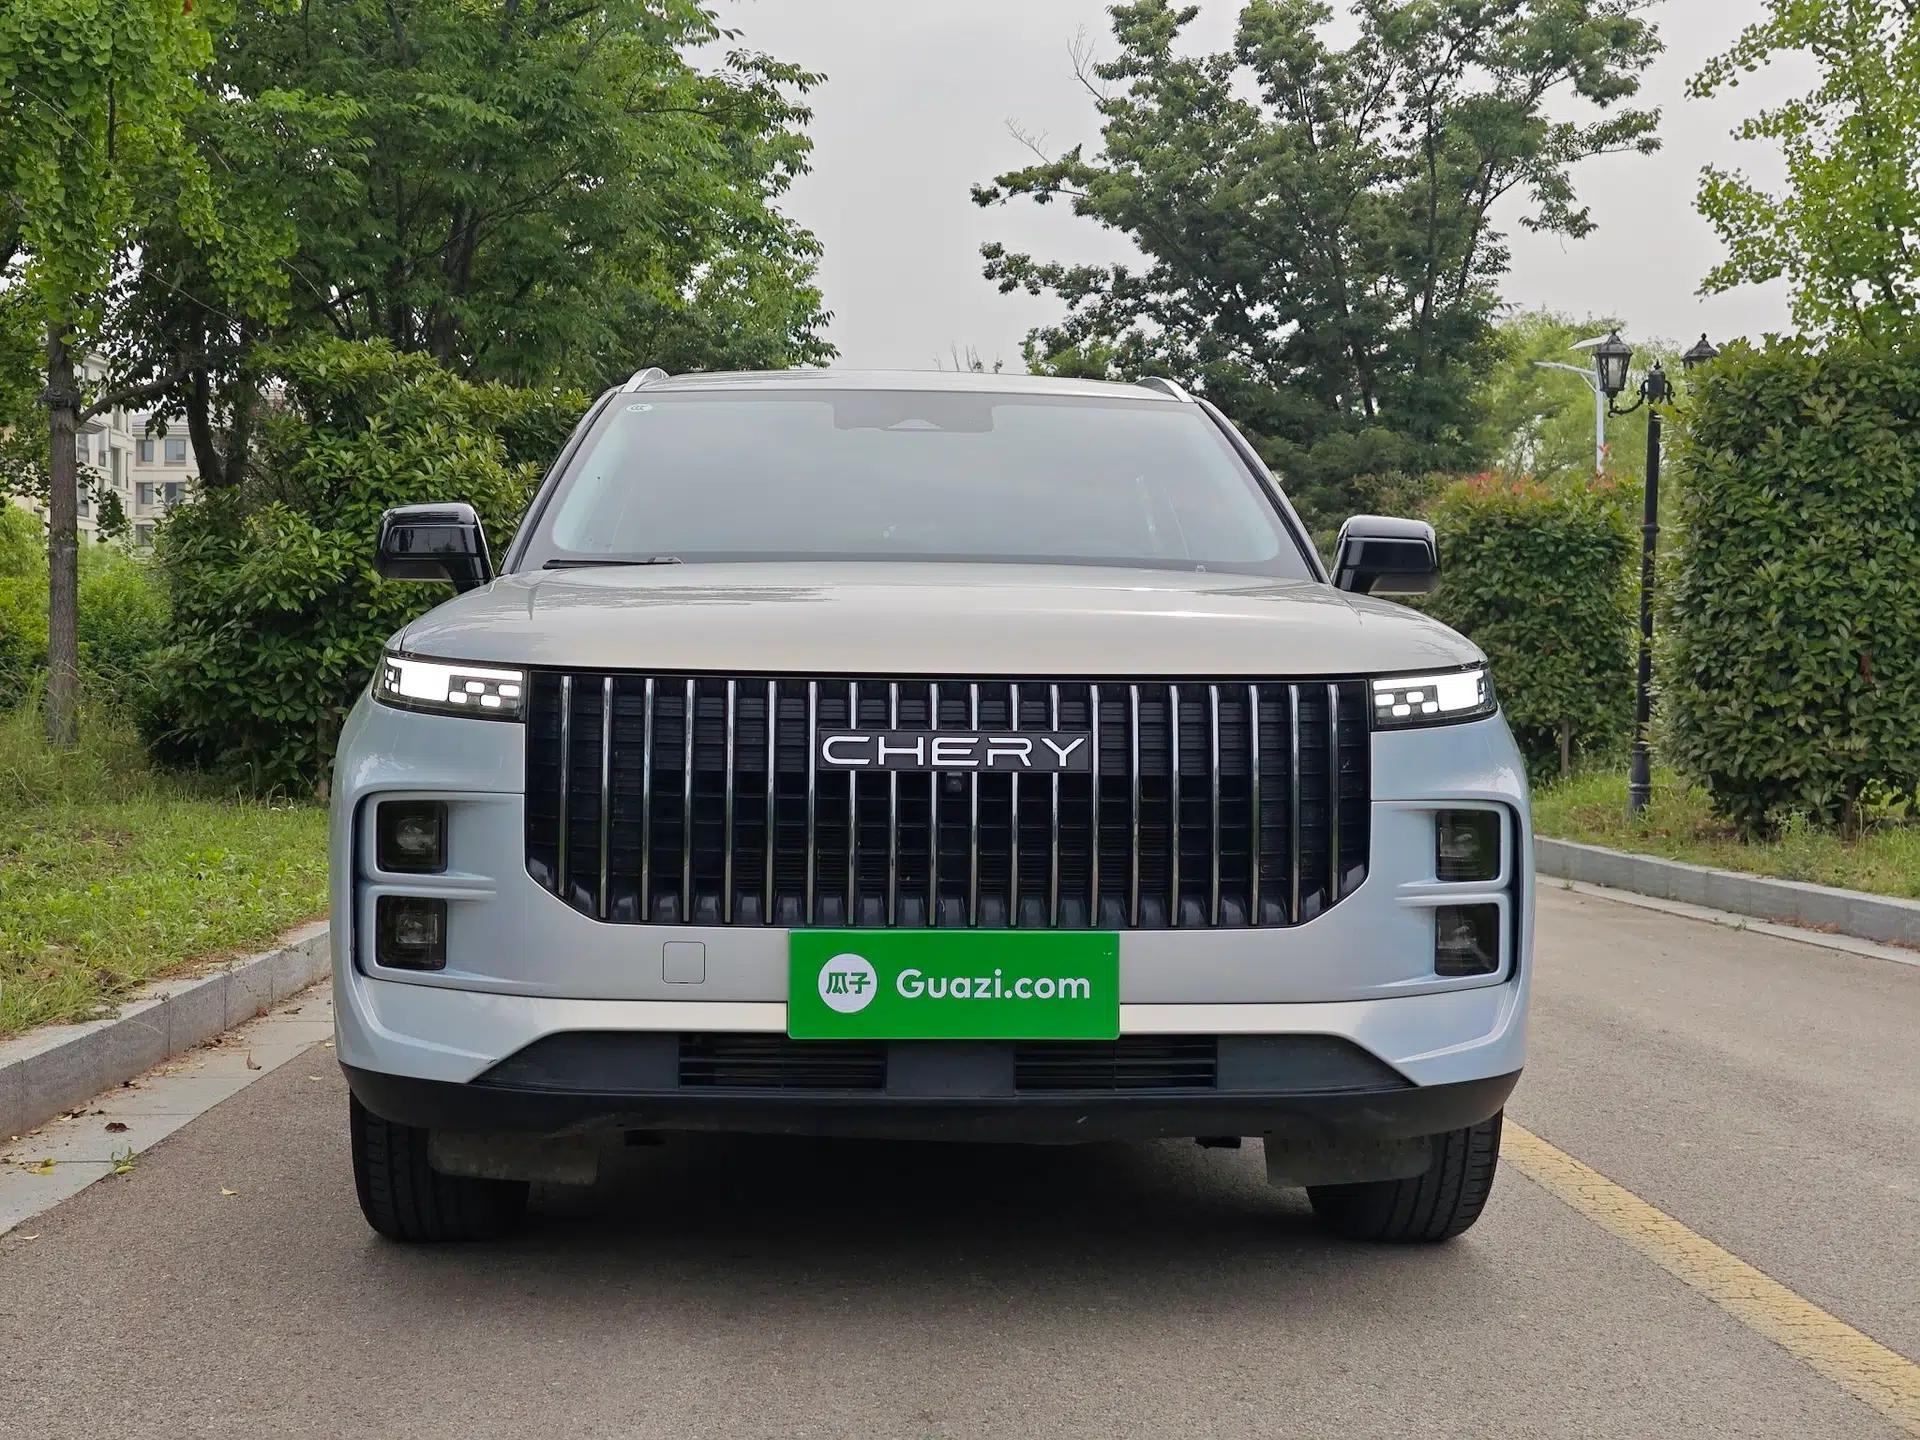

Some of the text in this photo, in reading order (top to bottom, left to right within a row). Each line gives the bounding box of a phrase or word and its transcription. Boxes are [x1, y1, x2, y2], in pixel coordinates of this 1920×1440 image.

[822, 736, 1085, 767] CHERY
[826, 972, 871, 994] 瓜子
[896, 968, 1090, 999] Guazi.com
